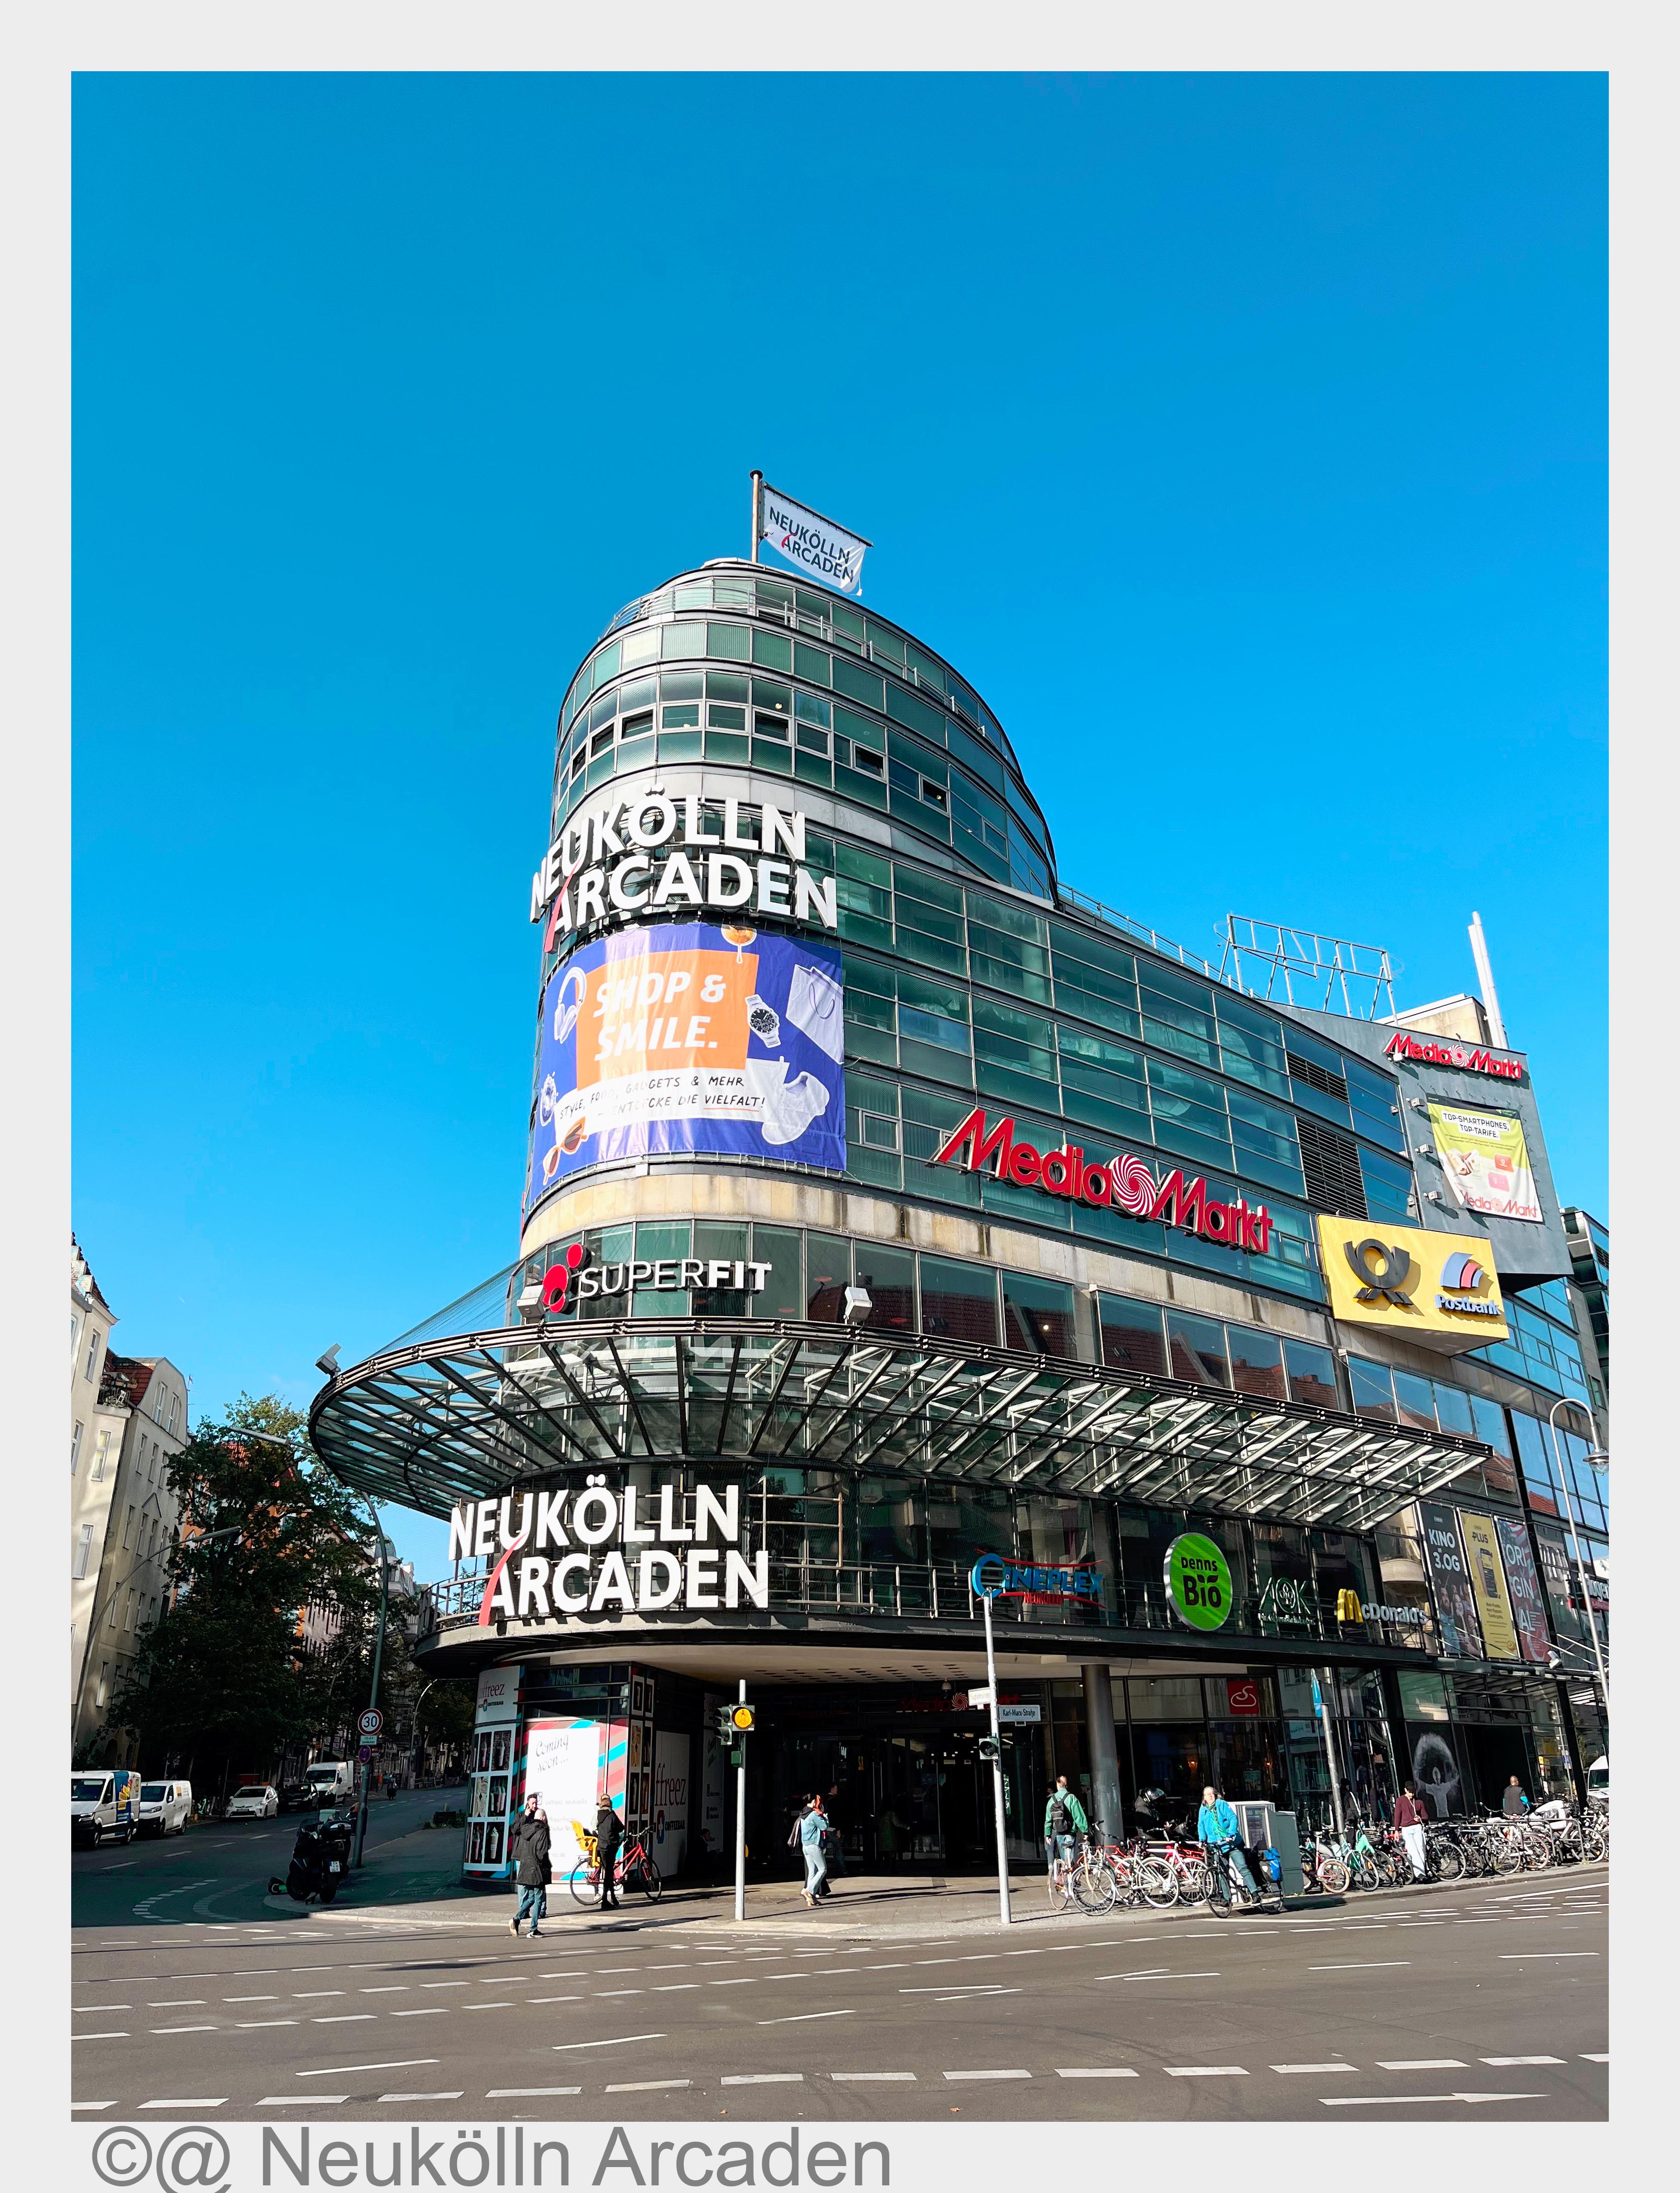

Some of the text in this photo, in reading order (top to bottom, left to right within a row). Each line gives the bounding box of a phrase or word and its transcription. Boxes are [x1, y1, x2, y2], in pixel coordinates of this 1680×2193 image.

[769, 506, 850, 564] NEUKÖLLN
[782, 534, 854, 583] ARCADEN
[529, 782, 806, 923] NEUKÖLLN
[544, 852, 836, 954] ARCADEN
[593, 970, 726, 1018] SHOP &
[594, 1016, 717, 1061] SMILE.
[1383, 1033, 1522, 1079] Media Markt
[560, 1099, 585, 1119] STYLE,
[626, 1077, 681, 1094] GADGETS
[691, 1076, 700, 1086] &
[708, 1076, 744, 1087] MEHR
[678, 1094, 698, 1105] DIE
[704, 1095, 766, 1108] VIELFALT!
[1443, 1113, 1510, 1131] TOP-SMARTPHONES,
[1460, 1124, 1498, 1138] TOP-TARIFE.
[934, 1108, 1273, 1253] Media Markt
[1503, 1199, 1538, 1218] Markt
[580, 1259, 773, 1298] SUPERFIT
[1434, 1294, 1502, 1315] Postbank
[448, 1474, 739, 1560] NEUKÖLLN
[1428, 1528, 1456, 1549] KINO
[1506, 1544, 1527, 1567] ORI
[479, 1533, 769, 1626] ARCADEN
[972, 1553, 1104, 1598] CINEPLEX
[1433, 1552, 1461, 1572] 3.OG
[1259, 1577, 1312, 1614] AOK
[1512, 1576, 1535, 1599] GIN
[1337, 1588, 1428, 1625] McDonald's
[364, 1715, 377, 1728] 30
[1003, 1708, 1036, 1718] Karl-Marx-Straße
[536, 1735, 569, 1757] Coming
